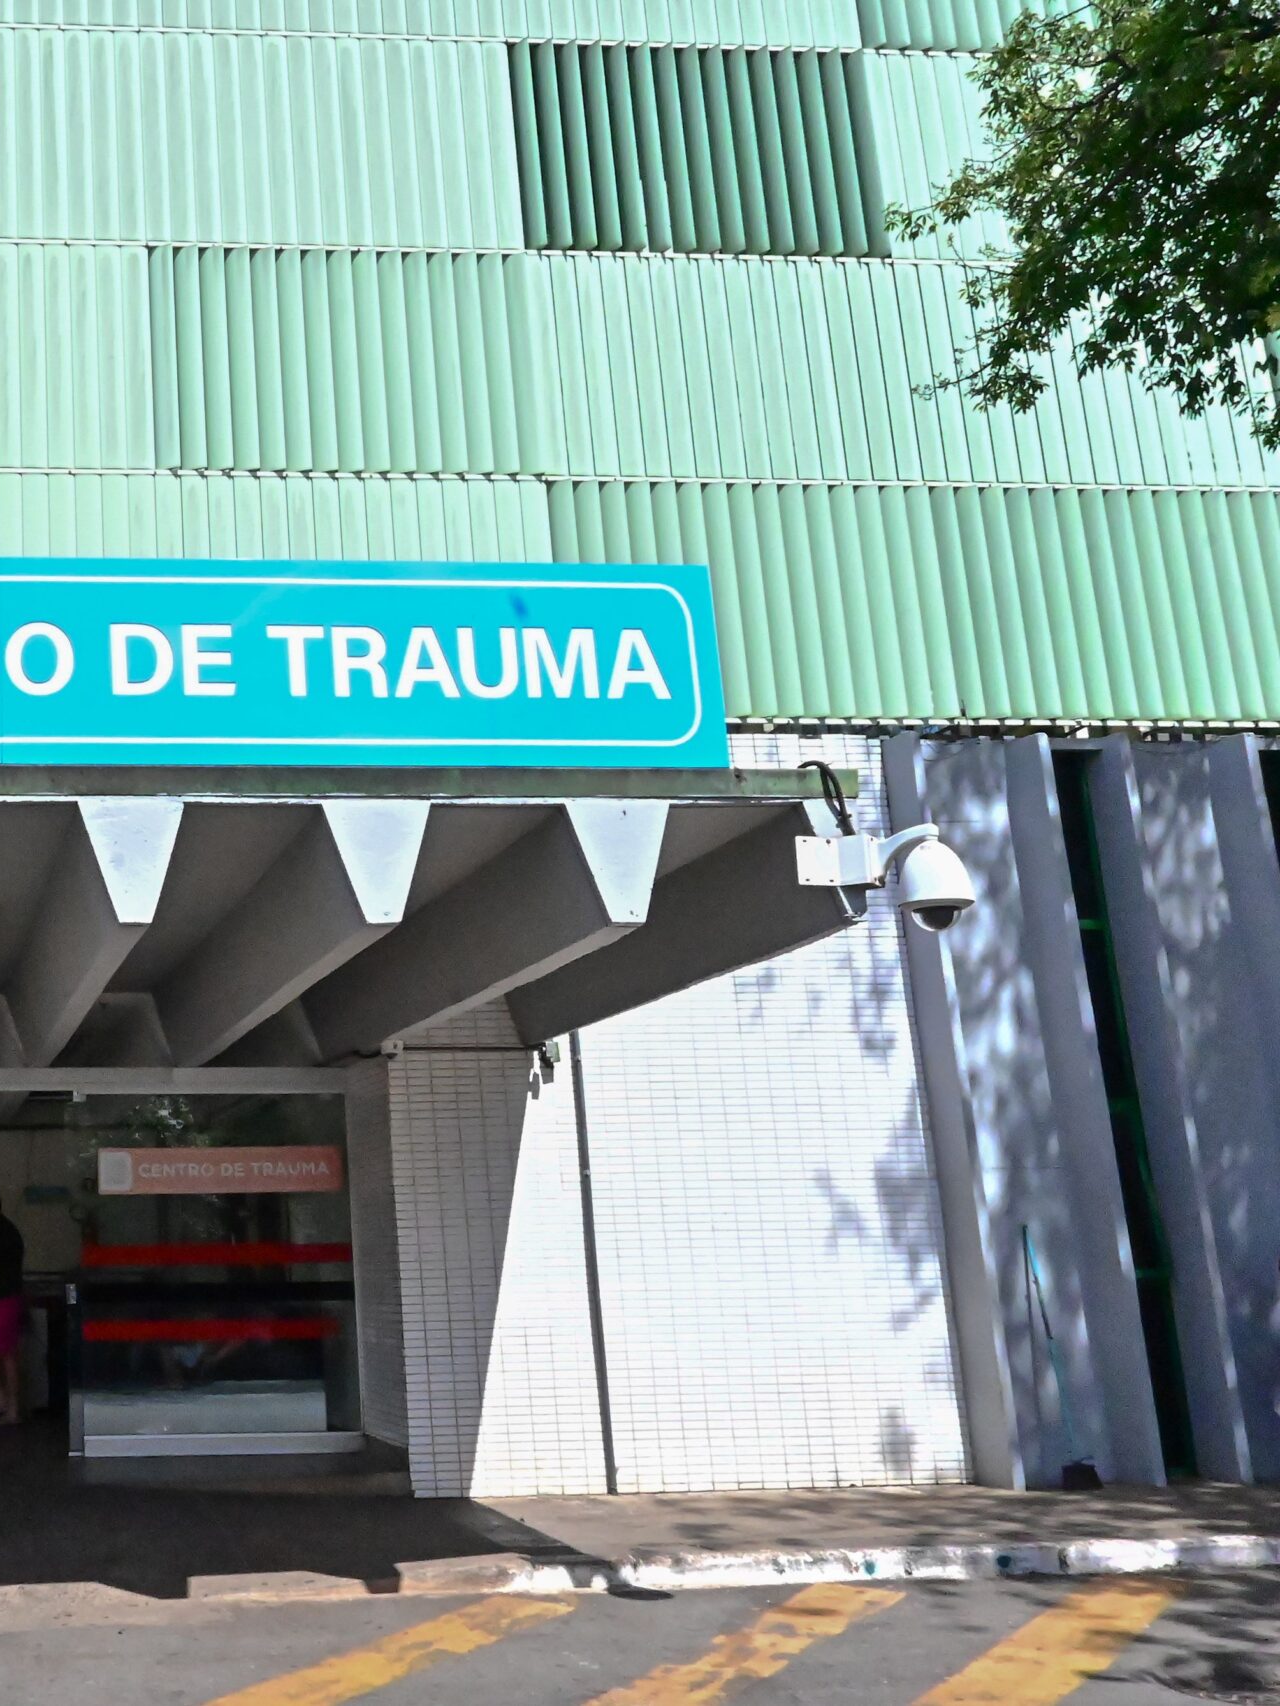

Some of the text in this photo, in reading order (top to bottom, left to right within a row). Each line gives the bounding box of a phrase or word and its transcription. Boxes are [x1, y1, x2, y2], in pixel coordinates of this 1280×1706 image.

[109, 622, 238, 697] DE
[265, 625, 673, 700] TRAUMA
[138, 1160, 330, 1179] CENTRO DE TRAUMA
